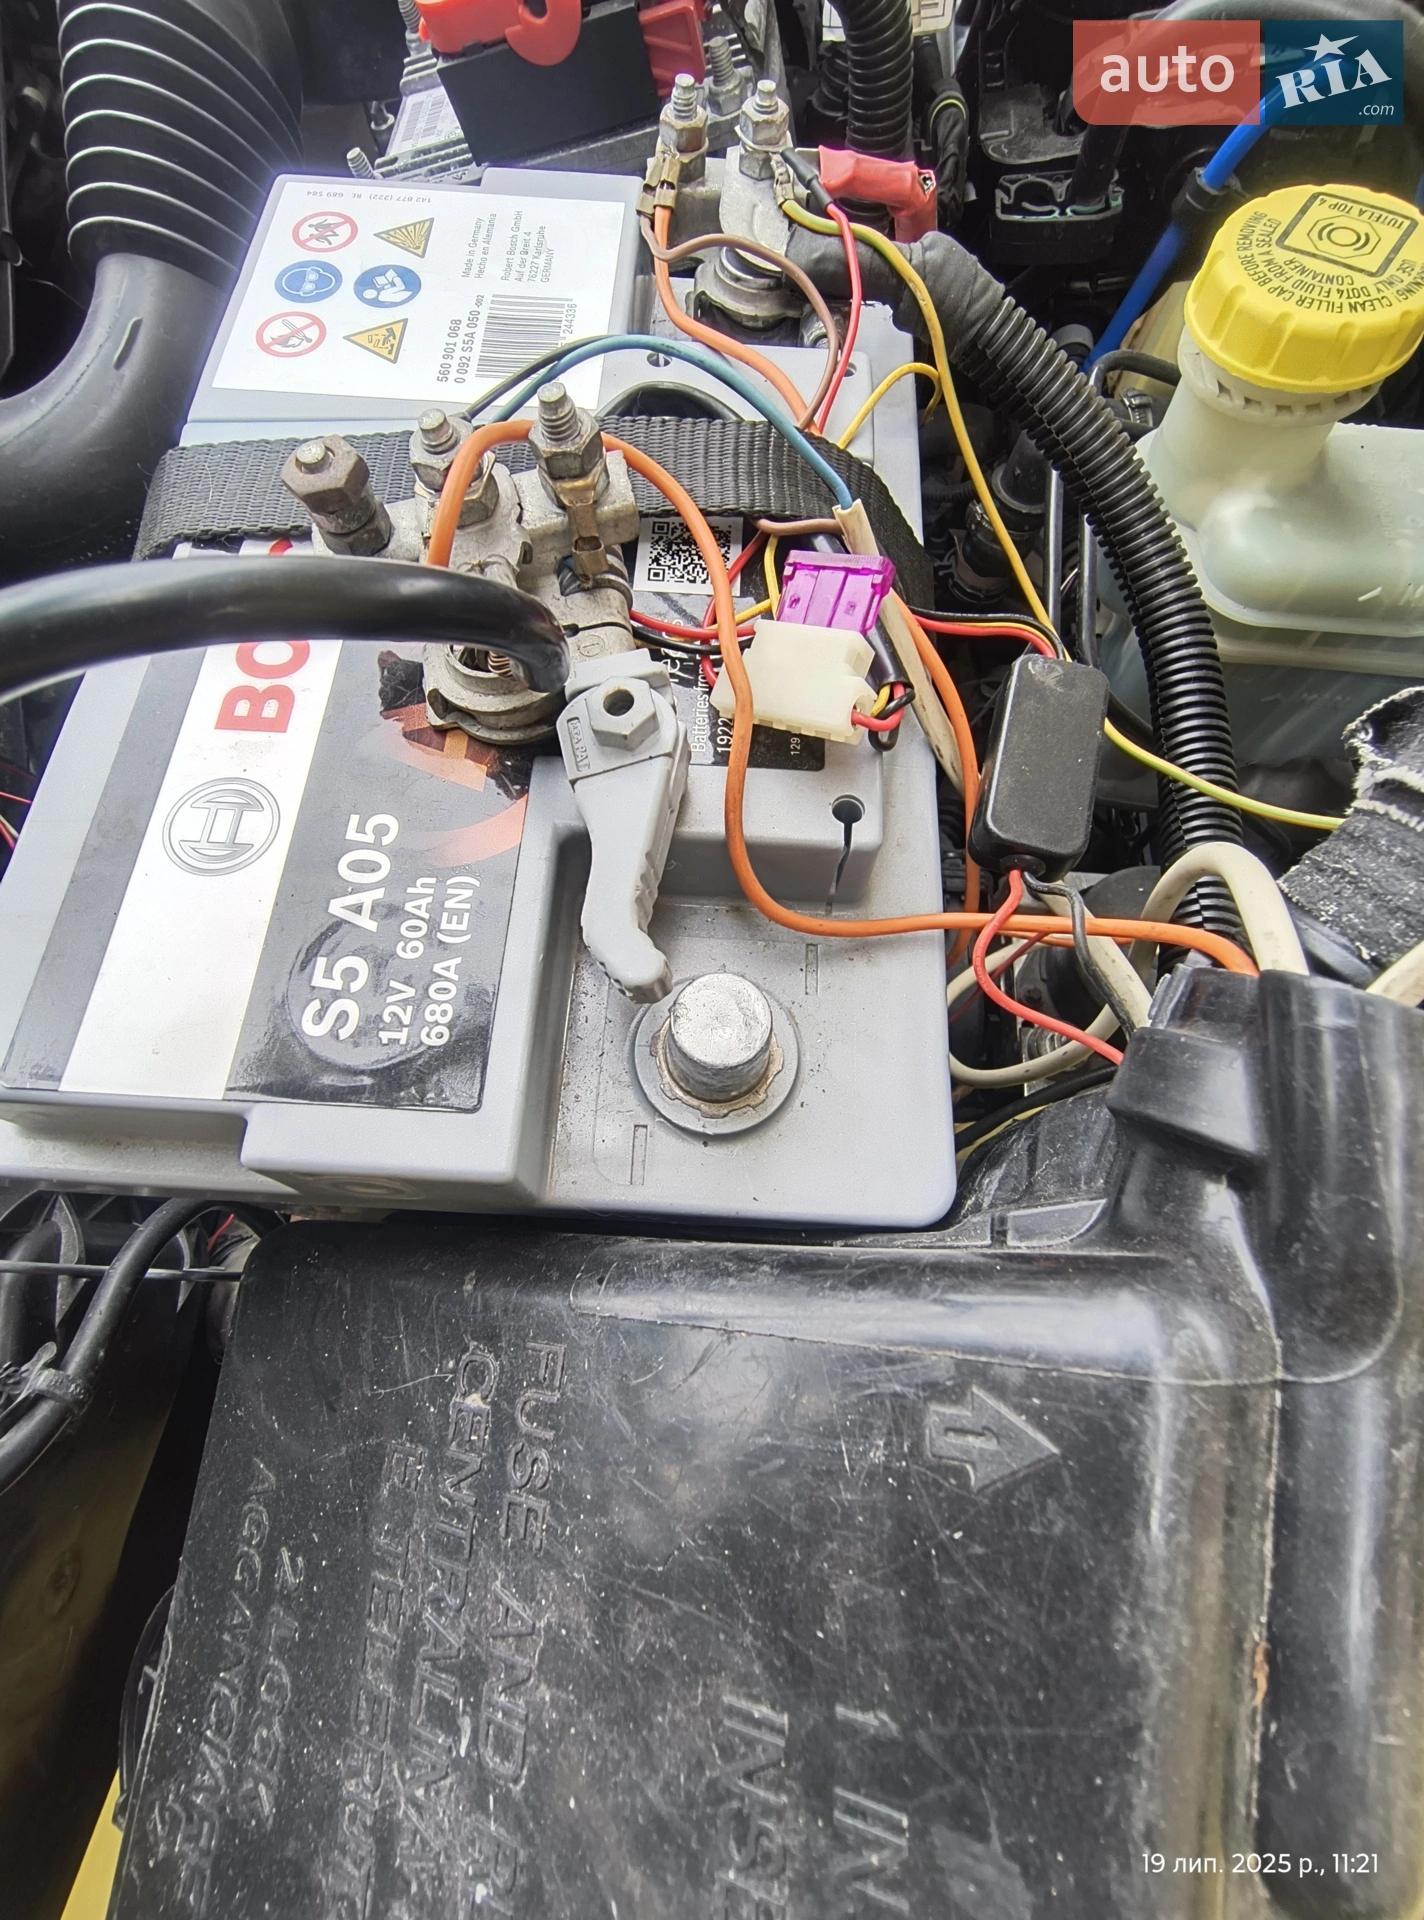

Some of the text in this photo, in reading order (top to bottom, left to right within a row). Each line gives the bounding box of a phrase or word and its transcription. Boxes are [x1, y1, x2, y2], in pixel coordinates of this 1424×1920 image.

[1317, 197, 1405, 230] TUTELA TOP 4
[474, 213, 497, 279] Hecho en Alemania
[500, 210, 523, 281] Robert Bosch GmbH
[520, 236, 530, 256] Breit
[1236, 211, 1268, 252] REMOVING
[1256, 218, 1282, 248] SEALED
[461, 217, 484, 278] Made in Germany
[516, 257, 526, 268] der
[527, 225, 546, 282] 76227 Karlsruhe
[1258, 249, 1274, 257] A
[514, 267, 525, 282] Auf
[540, 248, 555, 283] GERMANY
[1238, 253, 1273, 287] BEFORE
[1263, 256, 1294, 284] FROM
[1283, 256, 1355, 286] CONTAINER
[1267, 284, 1296, 302] CAP
[1292, 278, 1332, 299] FLUID
[1336, 285, 1371, 300] DOT4
[1373, 272, 1404, 295] ONLY
[563, 303, 577, 335] 244336
[1295, 294, 1344, 314] FILLER
[1349, 295, 1393, 314] CLEAN
[466, 310, 481, 330] 050
[437, 319, 462, 383] 560 901 068
[461, 331, 476, 353] S5A
[456, 356, 470, 376] 092
[691, 693, 709, 752] Batteries
[302, 812, 400, 1041] S5 A05
[378, 876, 438, 1046] 12V 60Ah
[420, 874, 482, 1048] 680A (EN)
[500, 1341, 567, 1556] FUSE
[478, 1582, 536, 1788] AND
